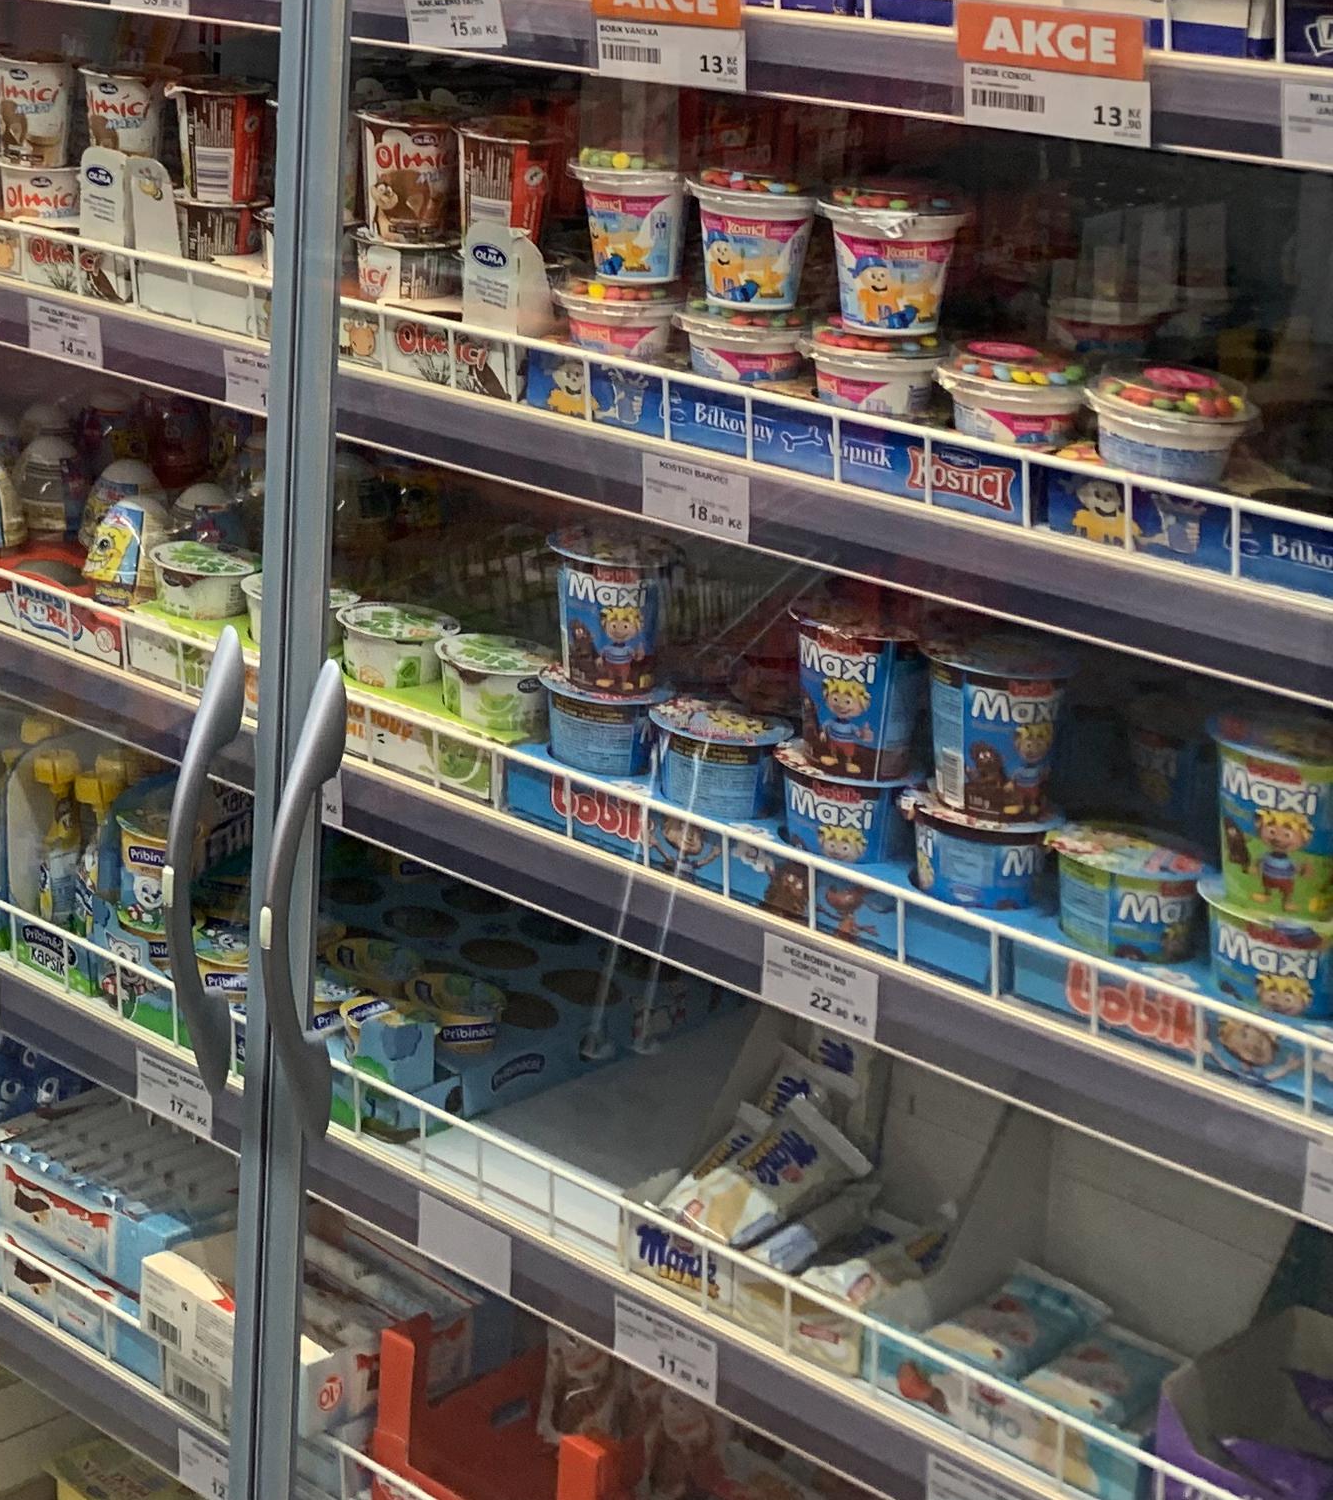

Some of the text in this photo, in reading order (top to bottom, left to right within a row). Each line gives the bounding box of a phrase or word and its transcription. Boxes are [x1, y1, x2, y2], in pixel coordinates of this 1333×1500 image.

[983, 15, 1116, 65] AKCE
[699, 54, 724, 74] 13
[1093, 105, 1123, 127] 13
[474, 250, 505, 266] OLMA
[694, 402, 775, 445] Bílkovny
[728, 518, 743, 530] Kč
[568, 572, 648, 607] Maxi
[799, 632, 878, 685] Maxi
[791, 785, 875, 830] Maxi
[1222, 758, 1322, 816] Maxi
[1218, 924, 1319, 981] Maxi
